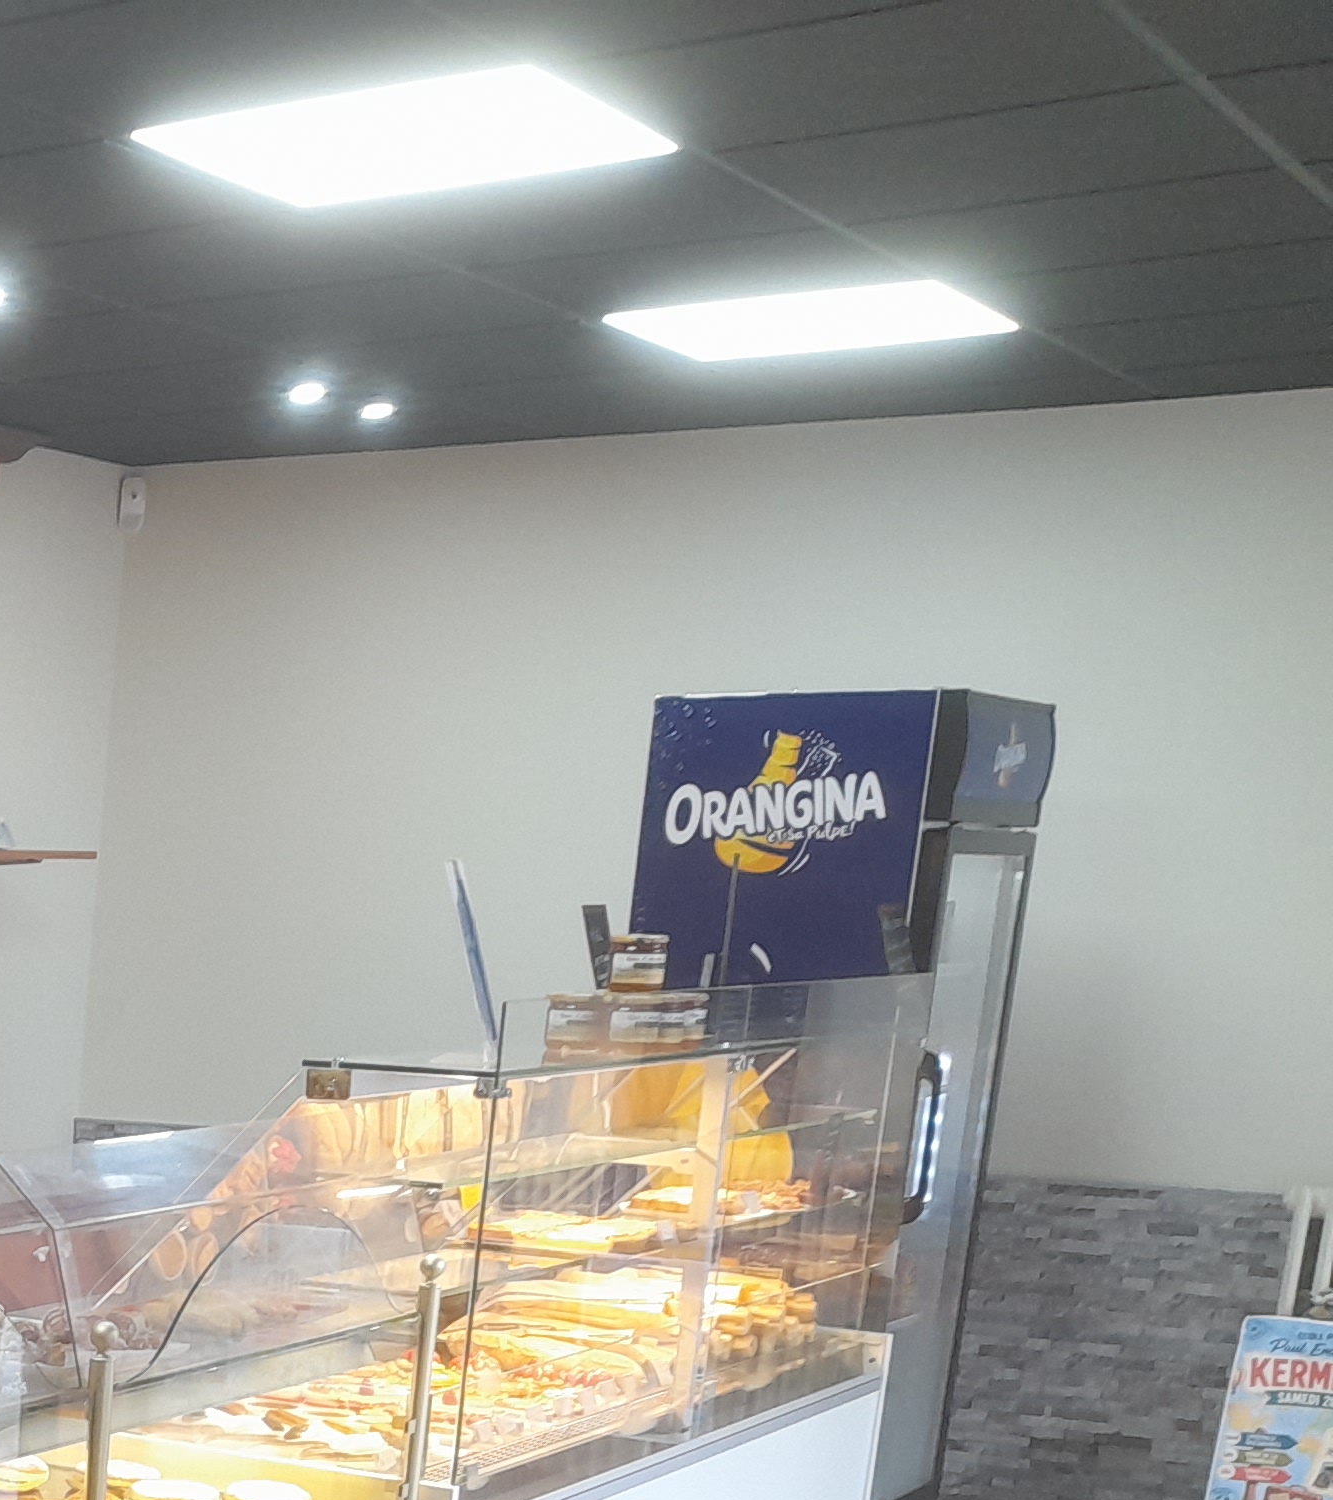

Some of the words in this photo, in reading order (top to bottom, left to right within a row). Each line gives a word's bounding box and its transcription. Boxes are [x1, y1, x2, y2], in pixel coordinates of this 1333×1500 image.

[664, 770, 887, 846] ORANGINA
[1269, 1337, 1308, 1353] Paul
[1249, 1356, 1333, 1391] KERM
